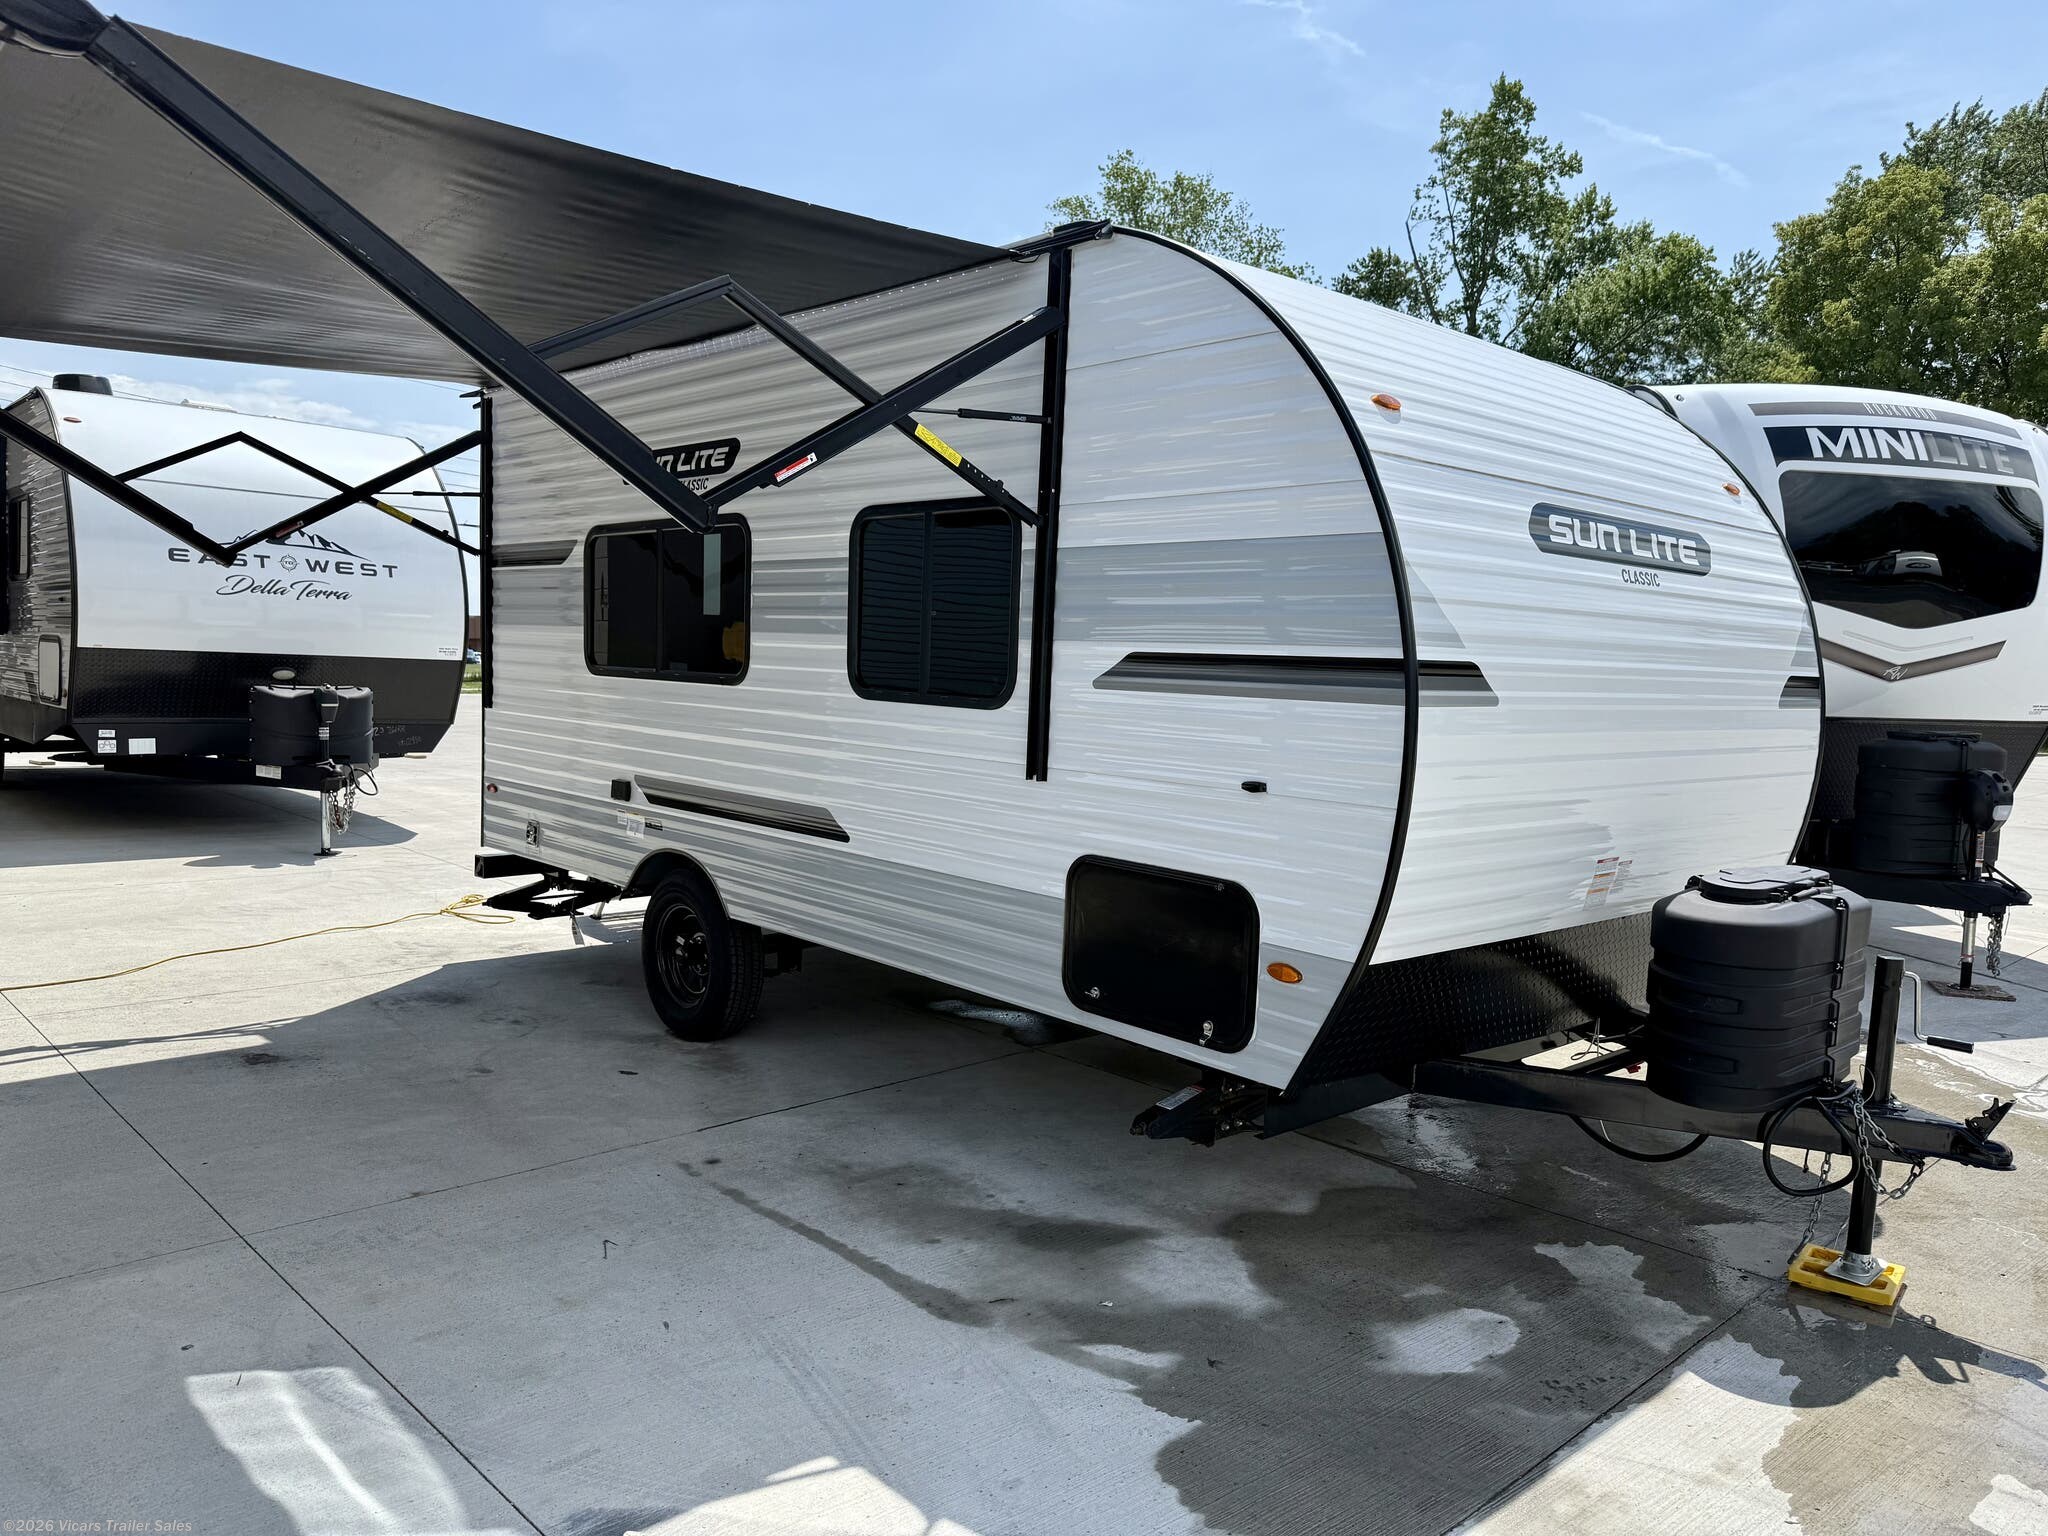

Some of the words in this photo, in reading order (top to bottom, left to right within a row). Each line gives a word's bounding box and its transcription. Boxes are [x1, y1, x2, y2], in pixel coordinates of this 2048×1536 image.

[1863, 402, 1937, 420] ROCKWOOD
[677, 446, 730, 472] LITE
[1549, 514, 1622, 553] SUN
[1630, 528, 1700, 566] LITE
[305, 558, 398, 578] WEST
[1621, 568, 1661, 587] CLASSIC
[216, 574, 290, 596] Della
[290, 580, 353, 601] Terra
